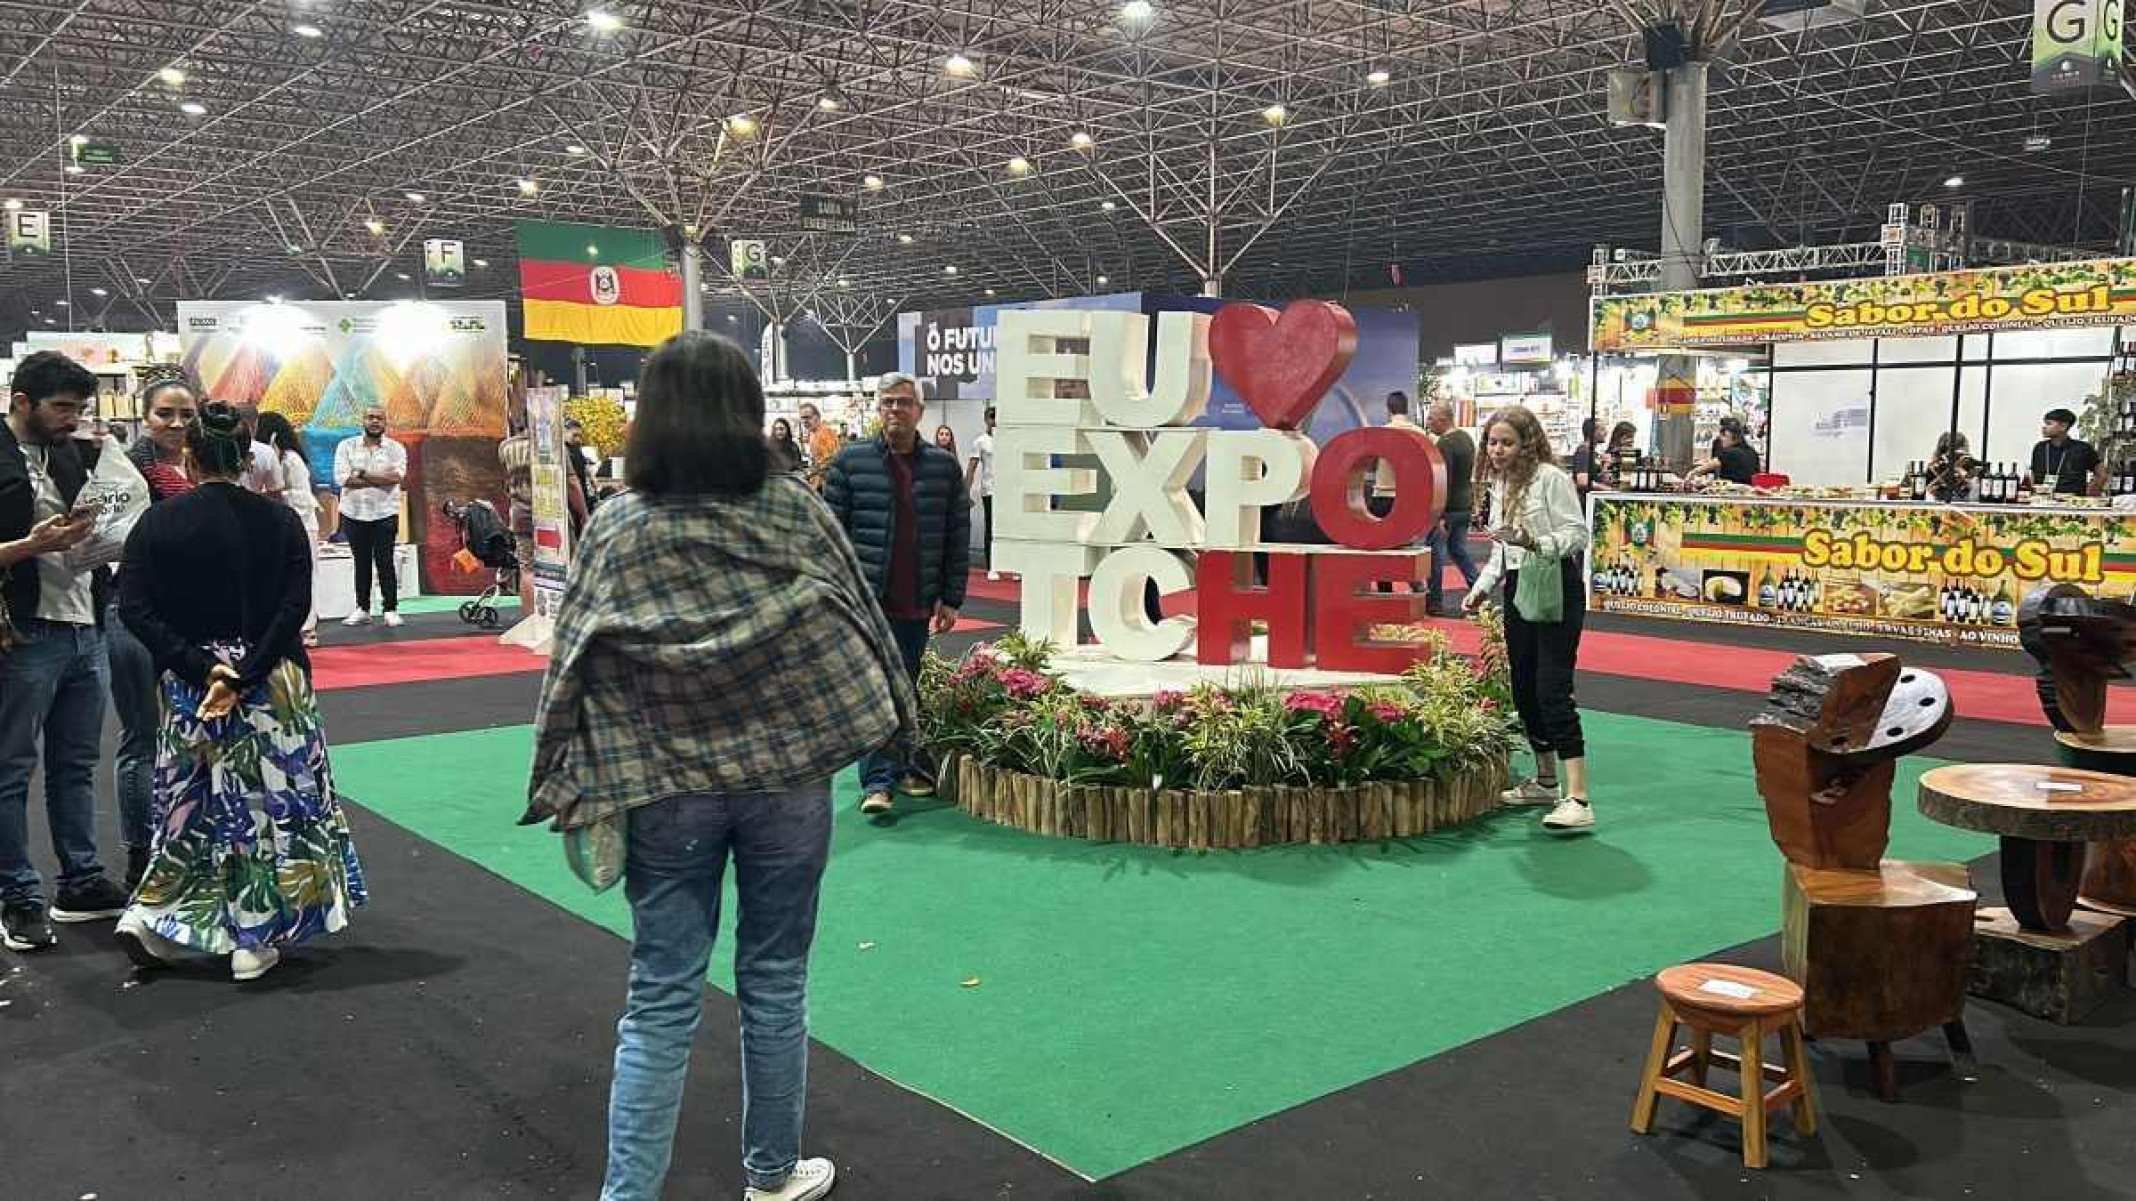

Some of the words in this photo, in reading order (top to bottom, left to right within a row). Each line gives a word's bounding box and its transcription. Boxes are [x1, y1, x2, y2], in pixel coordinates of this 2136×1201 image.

[2047, 1, 2085, 43] G
[2104, 0, 2119, 41] G
[17, 213, 39, 238] E
[441, 242, 457, 264] F
[745, 243, 761, 262] G
[1806, 299, 1938, 327] Sabor
[1948, 293, 2011, 320] do
[2020, 283, 2114, 316] Sul
[944, 326, 996, 350] FUTU
[926, 352, 964, 376] NOS
[967, 351, 995, 375] UN
[996, 310, 1212, 427] EU
[992, 427, 1448, 549] EXPO
[1803, 527, 1934, 572] Sabor
[1942, 536, 2006, 578] do
[2013, 538, 2105, 584] Sul
[991, 543, 1432, 675] TCHE
[1959, 630, 1976, 641] AO
